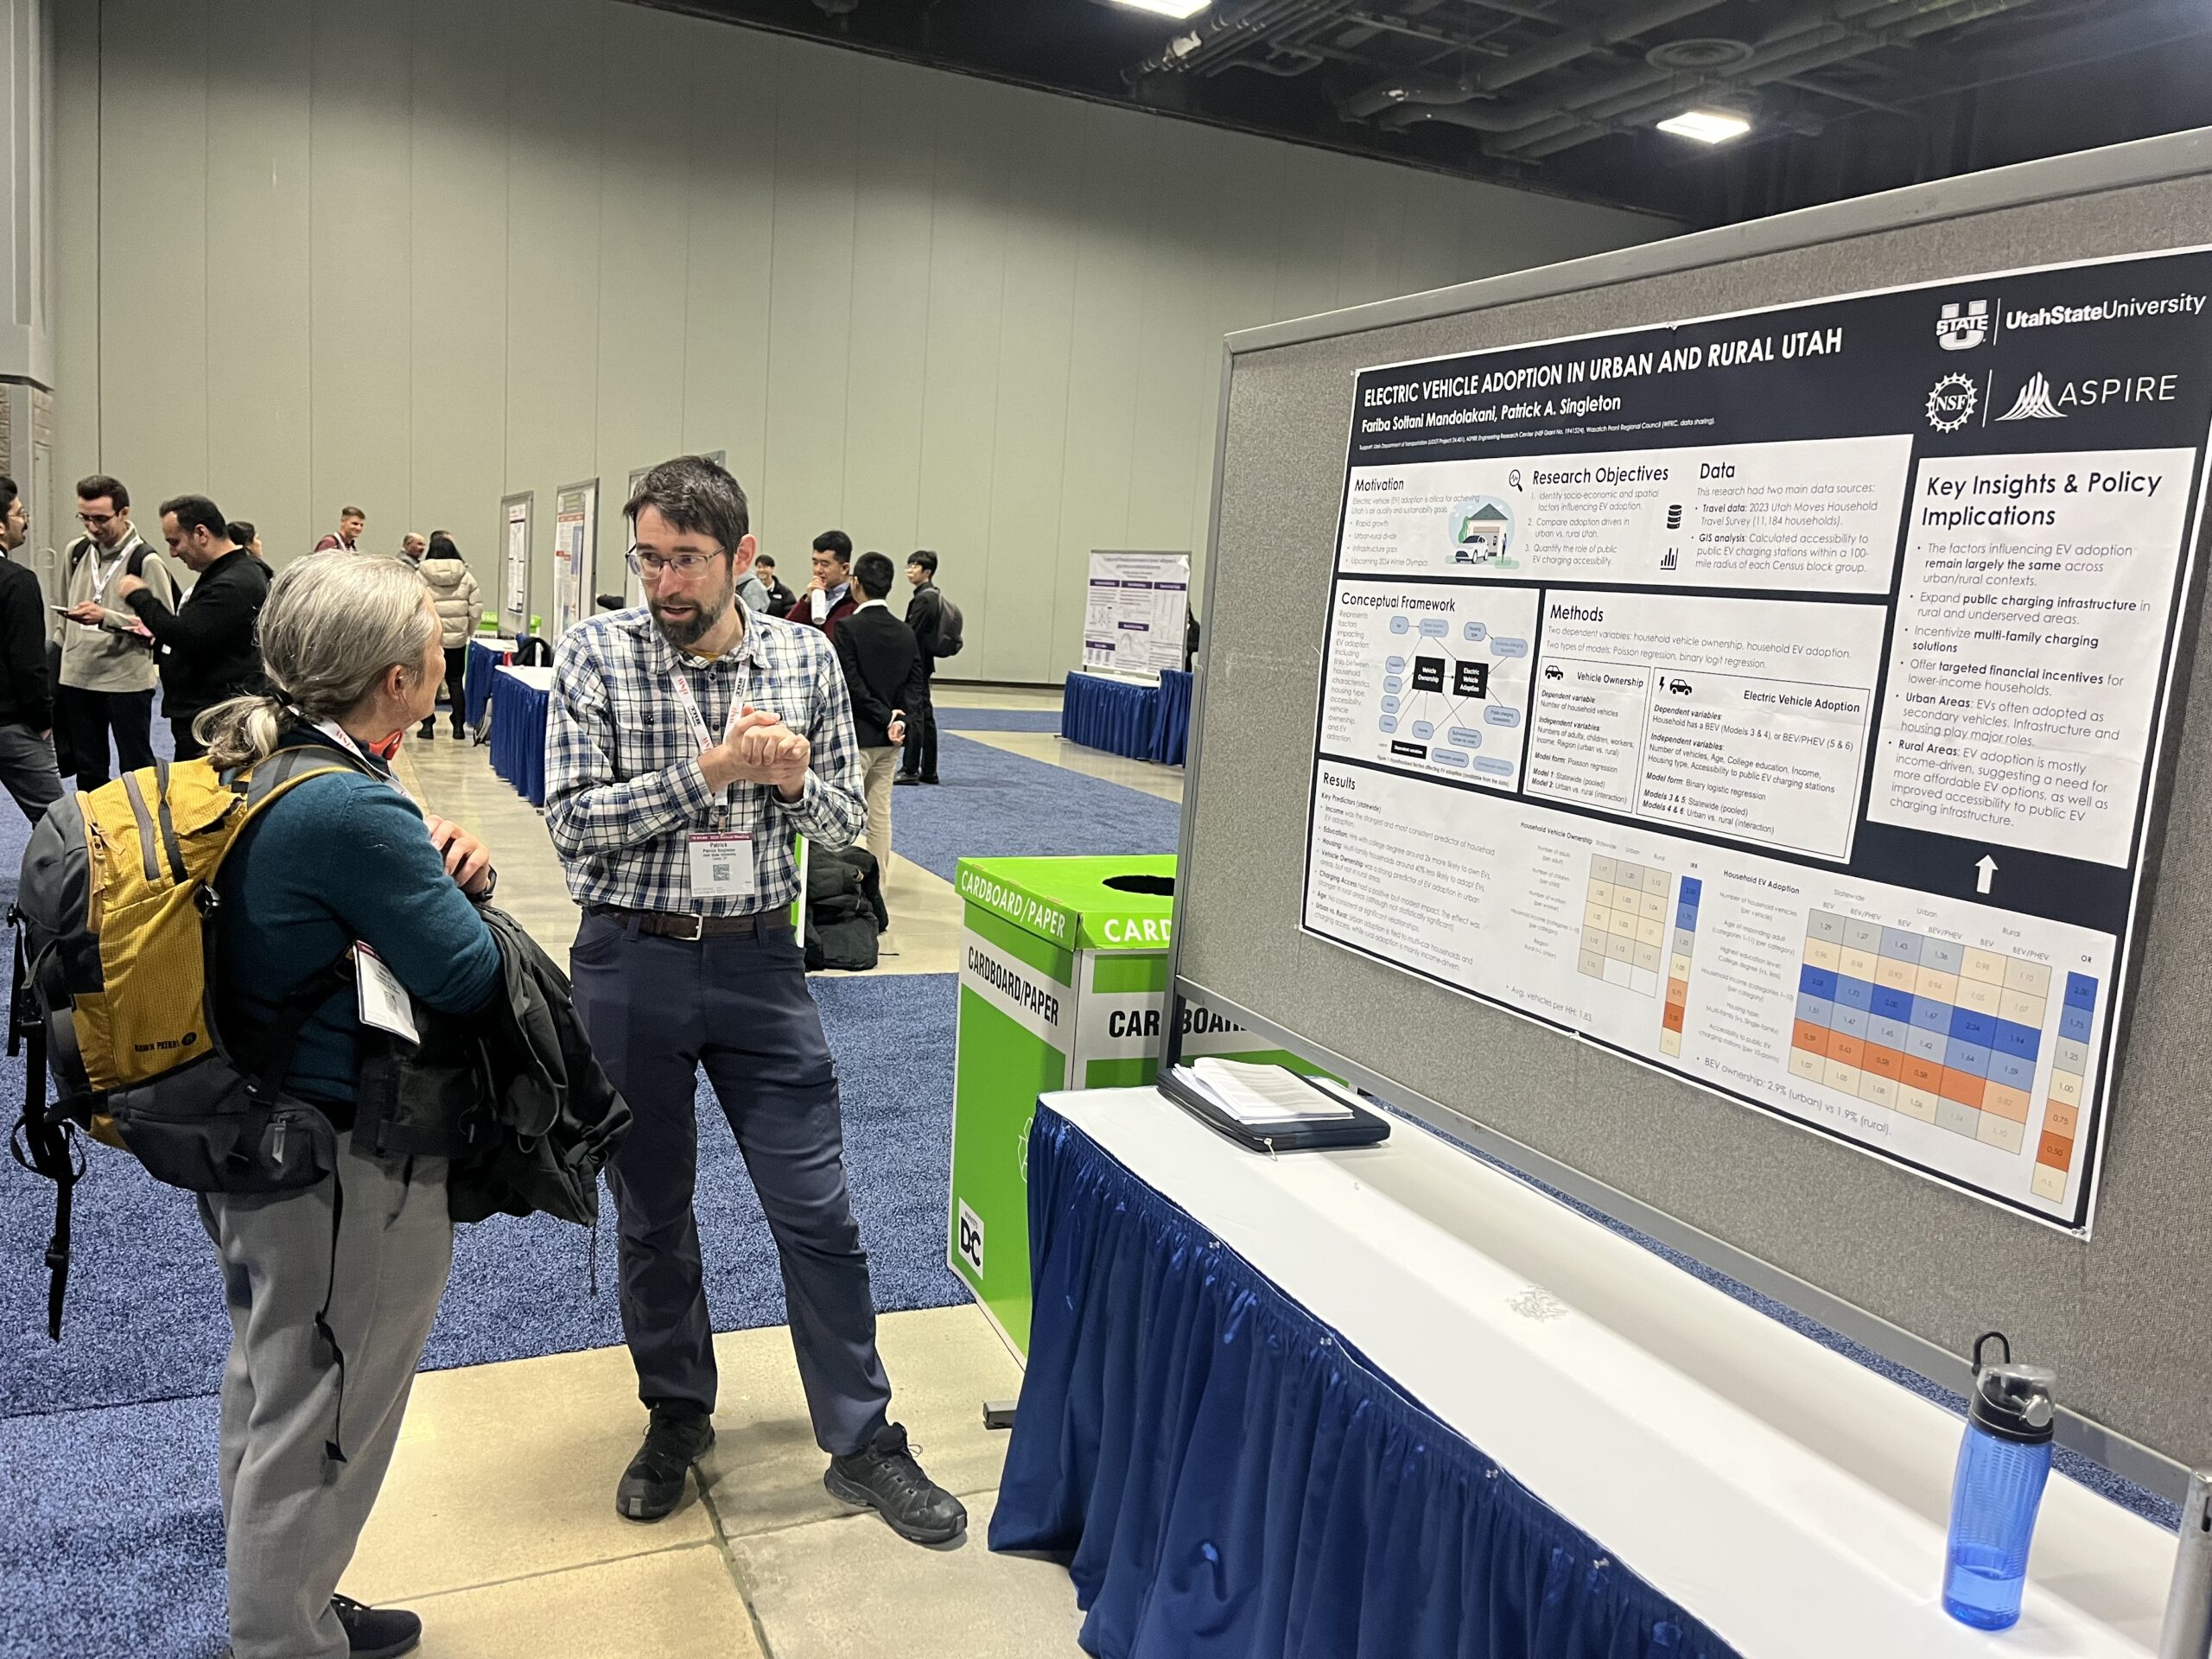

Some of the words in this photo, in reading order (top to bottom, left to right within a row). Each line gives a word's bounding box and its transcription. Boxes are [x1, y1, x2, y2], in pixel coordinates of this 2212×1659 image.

[2005, 292, 2207, 330] UtahStateUniversity
[1936, 315, 1989, 336] STATE
[1363, 381, 1420, 407] ELECTRIC
[1421, 373, 1479, 400] VEHICLE
[1479, 363, 1563, 394] ADOPTION
[1566, 359, 1586, 384] IN
[1588, 351, 1654, 381] URBAN
[1656, 346, 1702, 374] AND
[1707, 335, 1775, 368] RURAL
[1781, 326, 1842, 359] UTAH
[2056, 373, 2178, 407] ASPIRE
[1360, 416, 1391, 433] Fariba
[1391, 411, 1425, 431] Soltani
[1424, 404, 1498, 427] Mandolakani,
[1500, 400, 1542, 421] Patrick
[1542, 399, 1557, 416] A.
[1558, 393, 1621, 416] Singleton
[1935, 394, 1968, 412] NSF
[1531, 467, 1592, 485] Research
[1594, 464, 1669, 485] Objectives
[1699, 461, 1736, 480] Data
[1353, 476, 1404, 492] Motivation
[1926, 476, 1967, 500] Key
[1972, 472, 2056, 499] Insights
[2063, 473, 2078, 493] &
[2087, 469, 2163, 498] Policy
[1701, 502, 1726, 513] Travel
[1726, 502, 1747, 513] data:
[1748, 501, 1770, 512] 2023
[1770, 502, 1792, 512] Utah
[1793, 502, 1825, 512] Moves
[1826, 500, 1878, 512] Household
[1921, 504, 2056, 531] Implications
[1698, 531, 1713, 543] GIS
[1713, 532, 1745, 544] analysis:
[1748, 531, 1798, 543] Calculated
[1799, 532, 1857, 545] accessibility
[1858, 533, 1869, 543] to
[1927, 541, 1947, 554] The
[1948, 541, 1986, 555] factors
[1987, 541, 2053, 558] influencing
[2055, 543, 2073, 556] EV
[2073, 543, 2133, 558] adoption
[1695, 544, 1722, 557] public
[1722, 545, 1735, 556] EV
[1734, 545, 1772, 559] charging
[1772, 545, 1808, 557] stations
[1808, 547, 1838, 557] within
[1838, 549, 1847, 558] a
[1849, 546, 1870, 559] 100-
[1923, 557, 1962, 569] remain
[1964, 557, 2005, 572] largely
[2006, 558, 2025, 570] the
[2027, 561, 2062, 571] same
[2063, 562, 2104, 572] across
[1922, 572, 1984, 585] urban/rural
[1984, 574, 2037, 587] contexts.
[1340, 591, 1400, 609] Conceptual
[1400, 594, 1456, 613] Framework
[1548, 603, 1604, 623] Methods
[1919, 590, 1961, 603] Expand
[1961, 593, 1998, 606] public
[1999, 594, 2054, 610] charging
[2056, 595, 2137, 612] infrastructure
[2139, 598, 2151, 612] in
[1916, 607, 1942, 618] rural
[1942, 607, 1967, 620] and
[1967, 608, 2041, 623] underserved
[2042, 613, 2080, 625] areas.
[1911, 639, 1958, 653] solutions
[1914, 626, 1971, 639] Incentivize
[1973, 628, 2042, 645] multi-family
[2044, 632, 2100, 650] charging
[1576, 671, 1602, 683] Vehicle
[1602, 673, 1644, 690] Ownership
[1907, 672, 1982, 690] lower-income
[1983, 678, 2052, 696] households.
[1909, 658, 1936, 671] Offer
[1937, 660, 1987, 675] targeted
[1988, 664, 2040, 679] financial
[2041, 668, 2104, 685] incentives
[2107, 673, 2124, 686] for
[1742, 689, 1777, 703] Electric
[1777, 693, 1813, 708] Vehicle
[1813, 697, 1860, 713] Adoption
[1904, 690, 1936, 704] Urban
[1937, 694, 1971, 709] Areas:
[1975, 697, 1995, 711] EVs
[1998, 701, 2029, 714] often
[2031, 705, 2088, 721] adopted
[2088, 711, 2104, 722] as
[1899, 720, 1942, 738] housing
[1942, 725, 1968, 741] play
[1969, 729, 2004, 744] major
[2004, 733, 2036, 747] roles.
[1902, 707, 1960, 725] secondary
[1961, 713, 2010, 728] vehicles.
[2012, 717, 2092, 738] Infrastructure
[2094, 728, 2120, 741] and
[1897, 738, 1924, 752] Rural
[1925, 742, 1958, 757] Areas:
[1962, 747, 1978, 758] EV
[1979, 751, 2034, 766] adoption
[2036, 754, 2045, 769] is
[2046, 760, 2087, 776] mostly
[1322, 771, 1356, 791] Results
[1894, 754, 1975, 775] income-driven,
[1977, 766, 2041, 786] suggesting
[2042, 775, 2053, 785] a
[2054, 776, 2089, 791] need
[2090, 778, 2108, 793] for
[1890, 780, 1943, 799] improved
[1944, 791, 2012, 813] accessibility
[2012, 800, 2026, 813] to
[2027, 804, 2067, 820] public
[2068, 808, 2087, 822] EV
[1892, 768, 1922, 781] more
[1922, 772, 1981, 791] affordable
[1982, 779, 1999, 792] EV
[1999, 785, 2047, 801] options,
[2050, 791, 2065, 804] as
[2066, 794, 2093, 807] well
[2094, 798, 2108, 810] as
[1888, 796, 1938, 816] charging
[1939, 803, 2014, 827] infrastructure.
[1722, 868, 1758, 885] Household
[1757, 877, 1767, 887] EV
[1766, 880, 1800, 894] Adoption
[961, 870, 1065, 938] CARDBOARD/PAPER
[2080, 953, 2093, 963] OR
[968, 945, 1059, 1027] CARDBOARD/PAPER
[1703, 1056, 1720, 1070] BEV
[1720, 1064, 1766, 1087] ownership:
[1766, 1079, 1787, 1096] 2.9%
[1788, 1088, 1822, 1111] (urban)
[1823, 1103, 1834, 1114] vs
[1836, 1105, 1858, 1123] 1.9%
[1859, 1114, 1892, 1136] (rural).
[961, 1217, 982, 1267] DC
